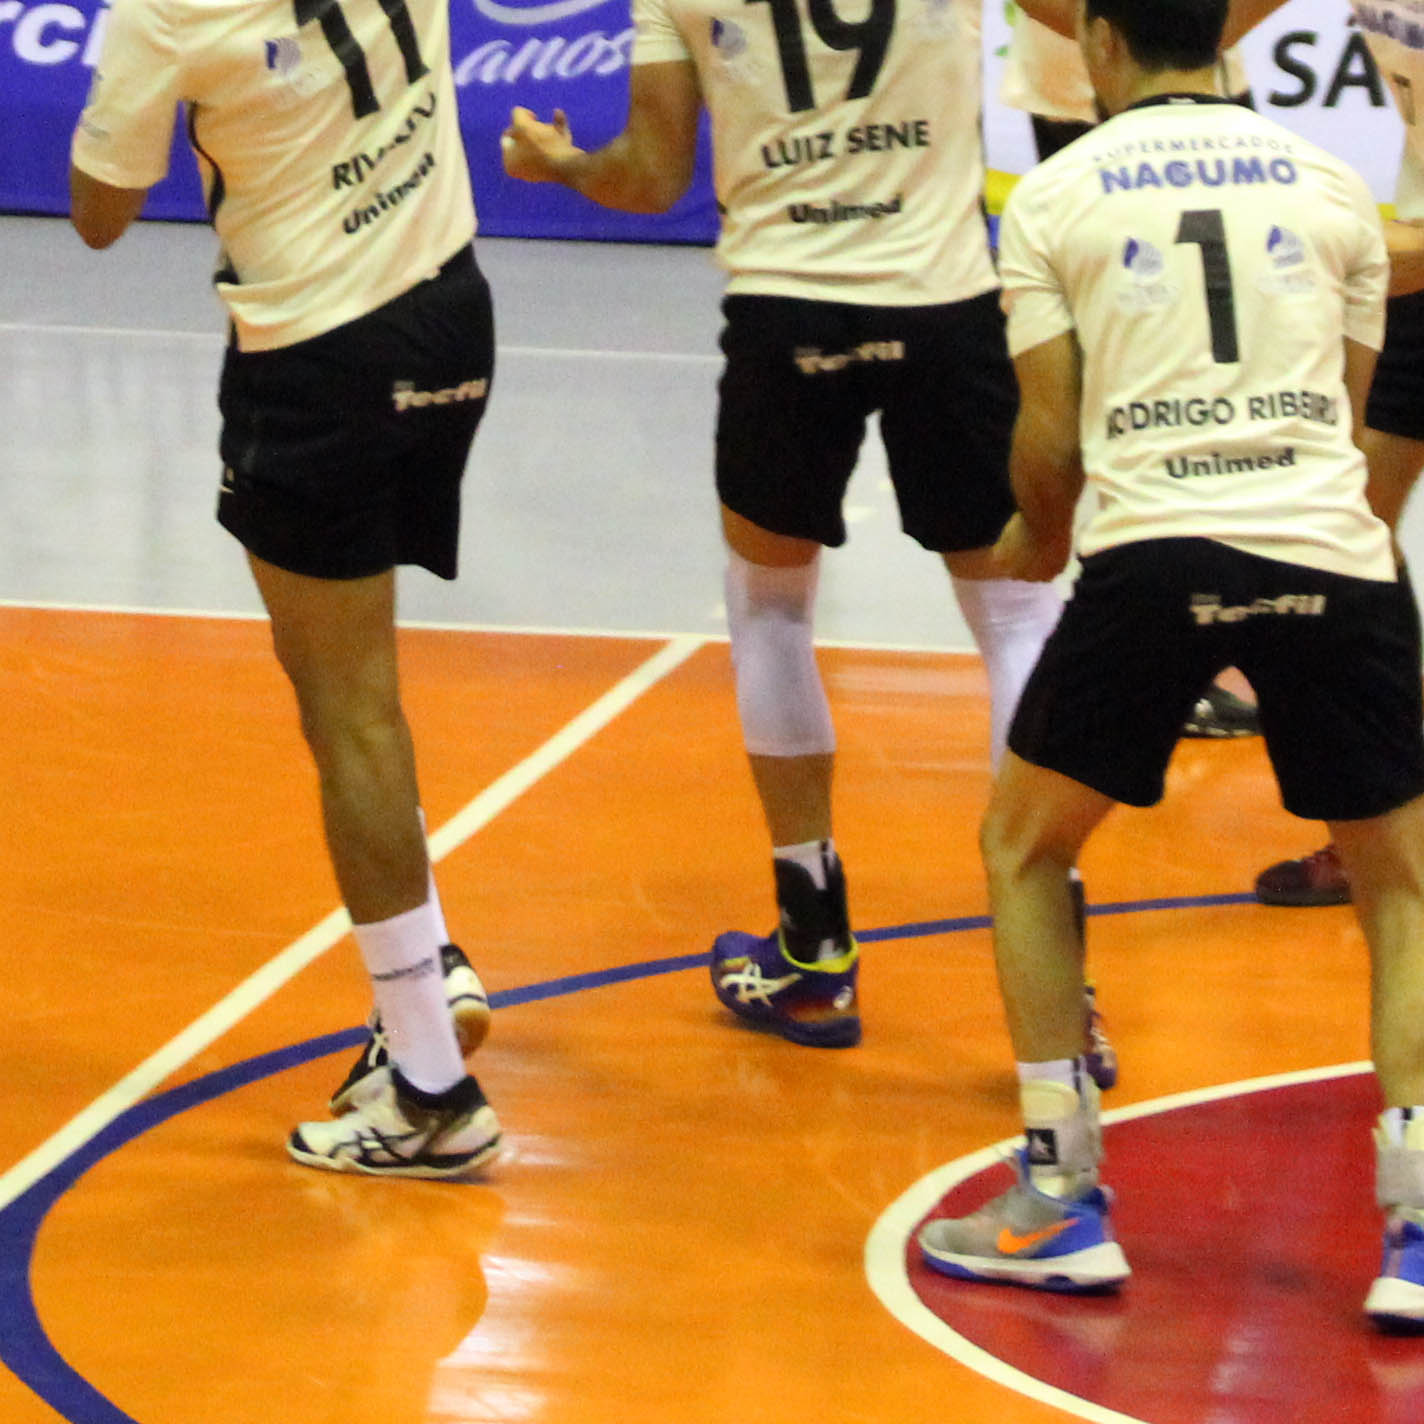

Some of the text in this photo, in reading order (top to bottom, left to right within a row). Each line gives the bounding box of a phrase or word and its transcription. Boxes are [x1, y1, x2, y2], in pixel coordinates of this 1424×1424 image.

[454, 28, 636, 86] anos
[761, 119, 931, 168] LUIZ SENE
[1098, 156, 1298, 195] NAGUMO
[1175, 208, 1239, 364] 1
[1164, 446, 1297, 479] Unimed
